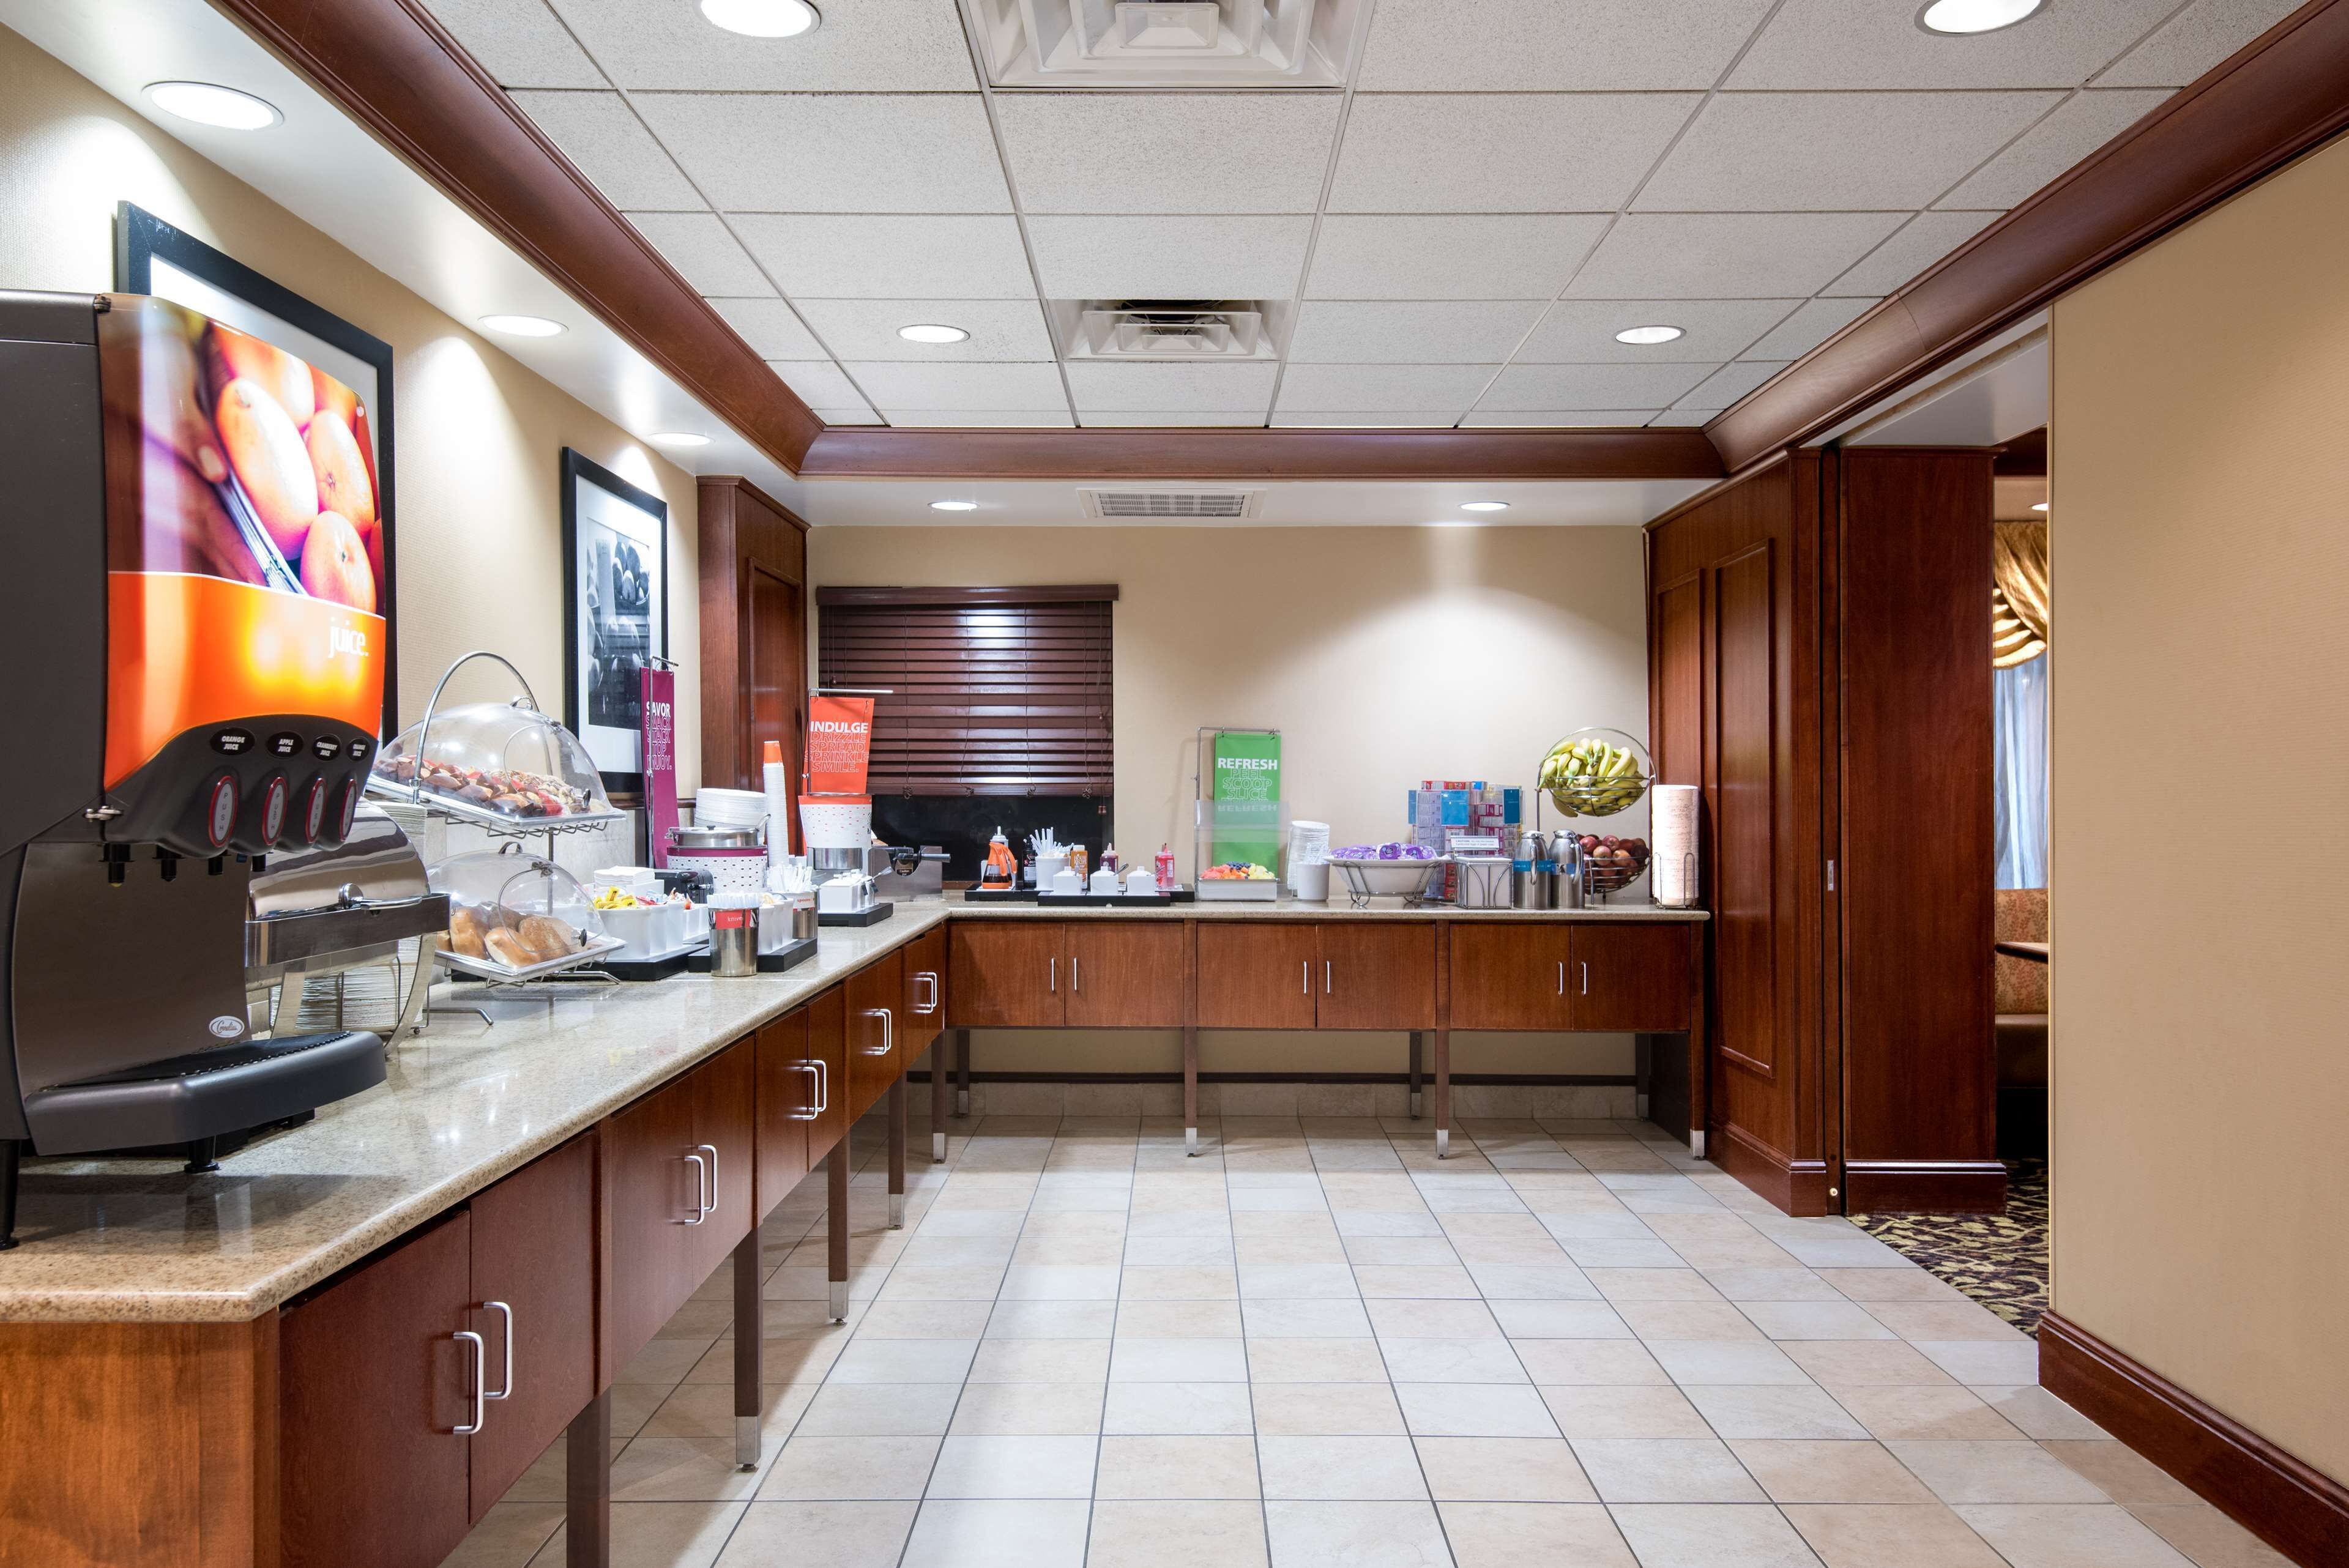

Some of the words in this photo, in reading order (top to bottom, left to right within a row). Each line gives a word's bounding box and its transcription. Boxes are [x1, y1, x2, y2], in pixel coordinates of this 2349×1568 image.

[810, 721, 868, 733] INDULGE
[811, 732, 866, 743] DRIZZLE
[810, 741, 866, 752] SPREAD
[804, 751, 869, 763] SPRINKLE
[812, 761, 859, 773] SMILE.
[1218, 758, 1278, 770] REFRESH
[1230, 768, 1265, 779] PEEL
[1223, 777, 1272, 790] SCOOP
[1227, 788, 1267, 800] SLICE
